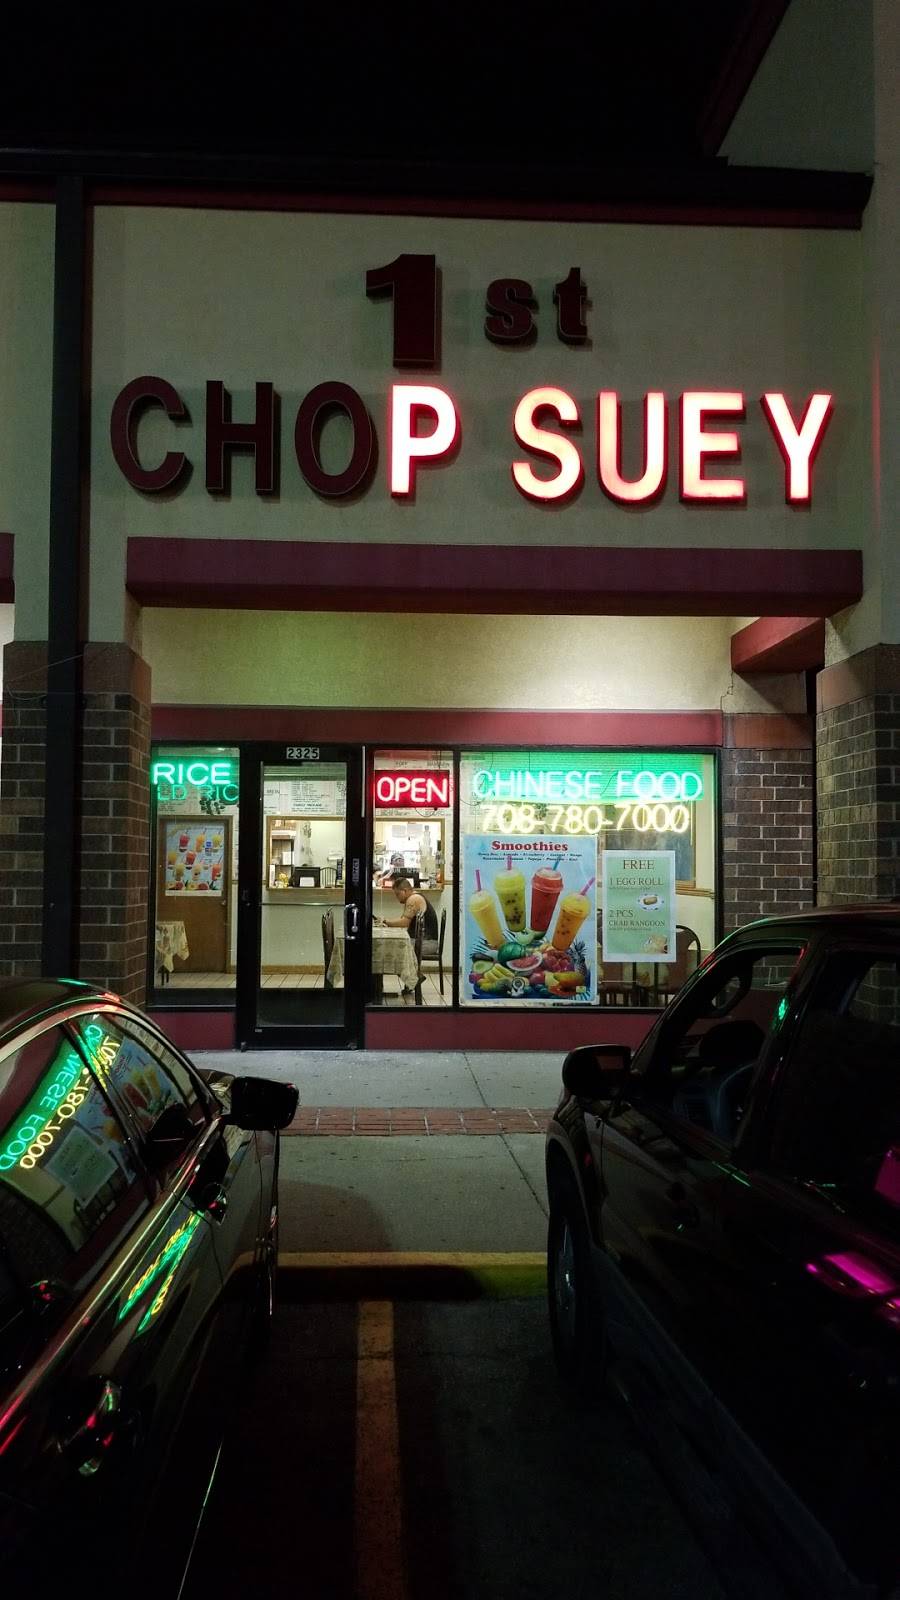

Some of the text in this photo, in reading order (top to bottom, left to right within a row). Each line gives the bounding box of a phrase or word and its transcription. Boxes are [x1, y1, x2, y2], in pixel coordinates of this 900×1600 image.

[109, 375, 834, 505] CHOP SUEY
[287, 747, 319, 759] 2325
[152, 762, 232, 786] RICE
[376, 776, 449, 803] OPEN
[472, 769, 704, 802] CHINESE FOOD
[480, 802, 691, 835] 708-780-7000
[491, 840, 568, 852] Smoothies
[623, 859, 655, 870] FREE
[616, 877, 636, 885] EGG
[638, 877, 664, 885] ROLL
[616, 909, 634, 918] PCS
